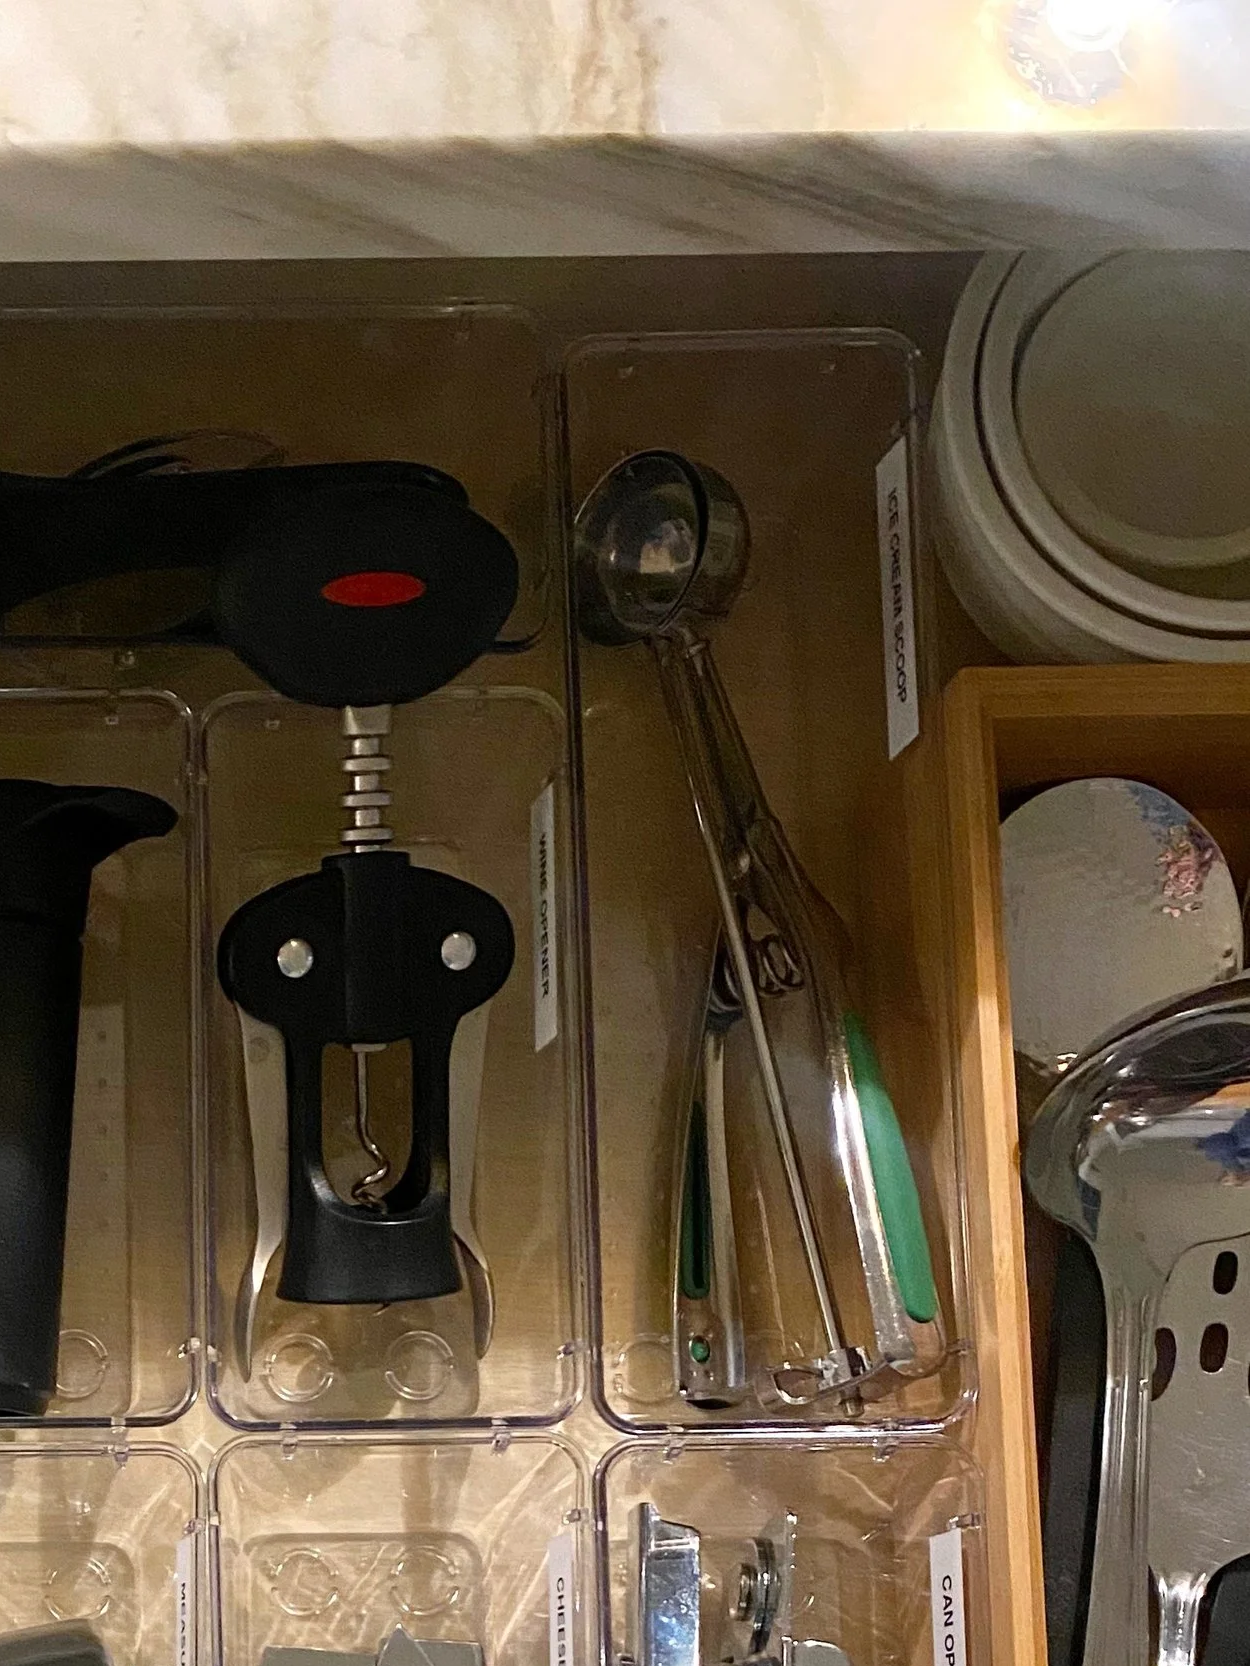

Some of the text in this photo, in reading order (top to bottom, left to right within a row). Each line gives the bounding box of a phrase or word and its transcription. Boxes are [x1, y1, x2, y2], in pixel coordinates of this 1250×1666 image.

[887, 487, 908, 703] ICE CREAM SCOOP
[539, 832, 550, 999] WINE OPENER
[942, 1574, 954, 1627] CAN
